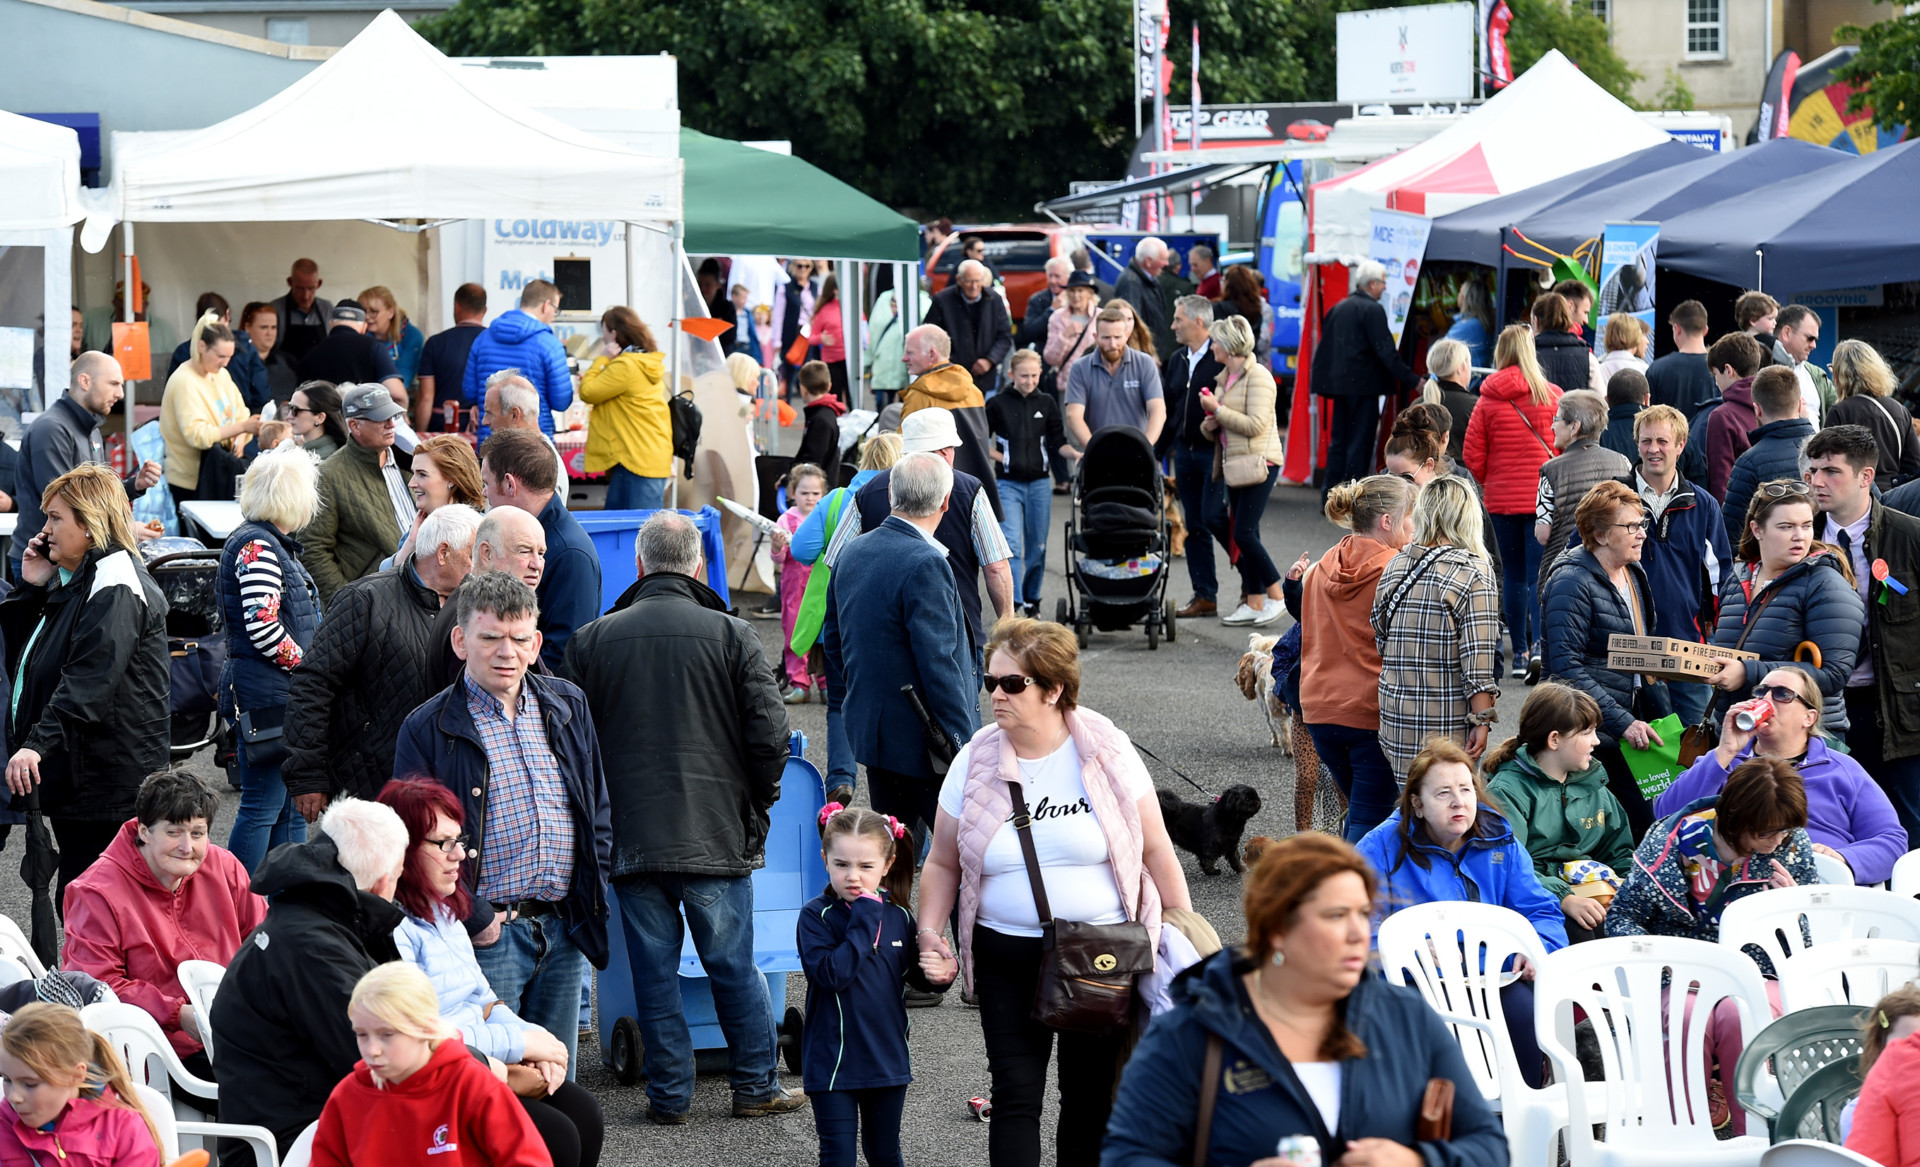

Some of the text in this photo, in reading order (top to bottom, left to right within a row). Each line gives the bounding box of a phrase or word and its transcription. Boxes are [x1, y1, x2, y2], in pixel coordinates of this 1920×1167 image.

[1212, 110, 1270, 128] GEAR
[495, 219, 614, 247] Coldway
[1794, 294, 1868, 305] GROOVING
[1386, 570, 1417, 618] JACOBS
[1611, 638, 1622, 648] FIRE
[1692, 646, 1708, 658] FIRE
[1612, 656, 1625, 666] FIRE
[1704, 663, 1717, 674] FIRE
[1648, 769, 1670, 782] loved
[1641, 778, 1672, 795] world
